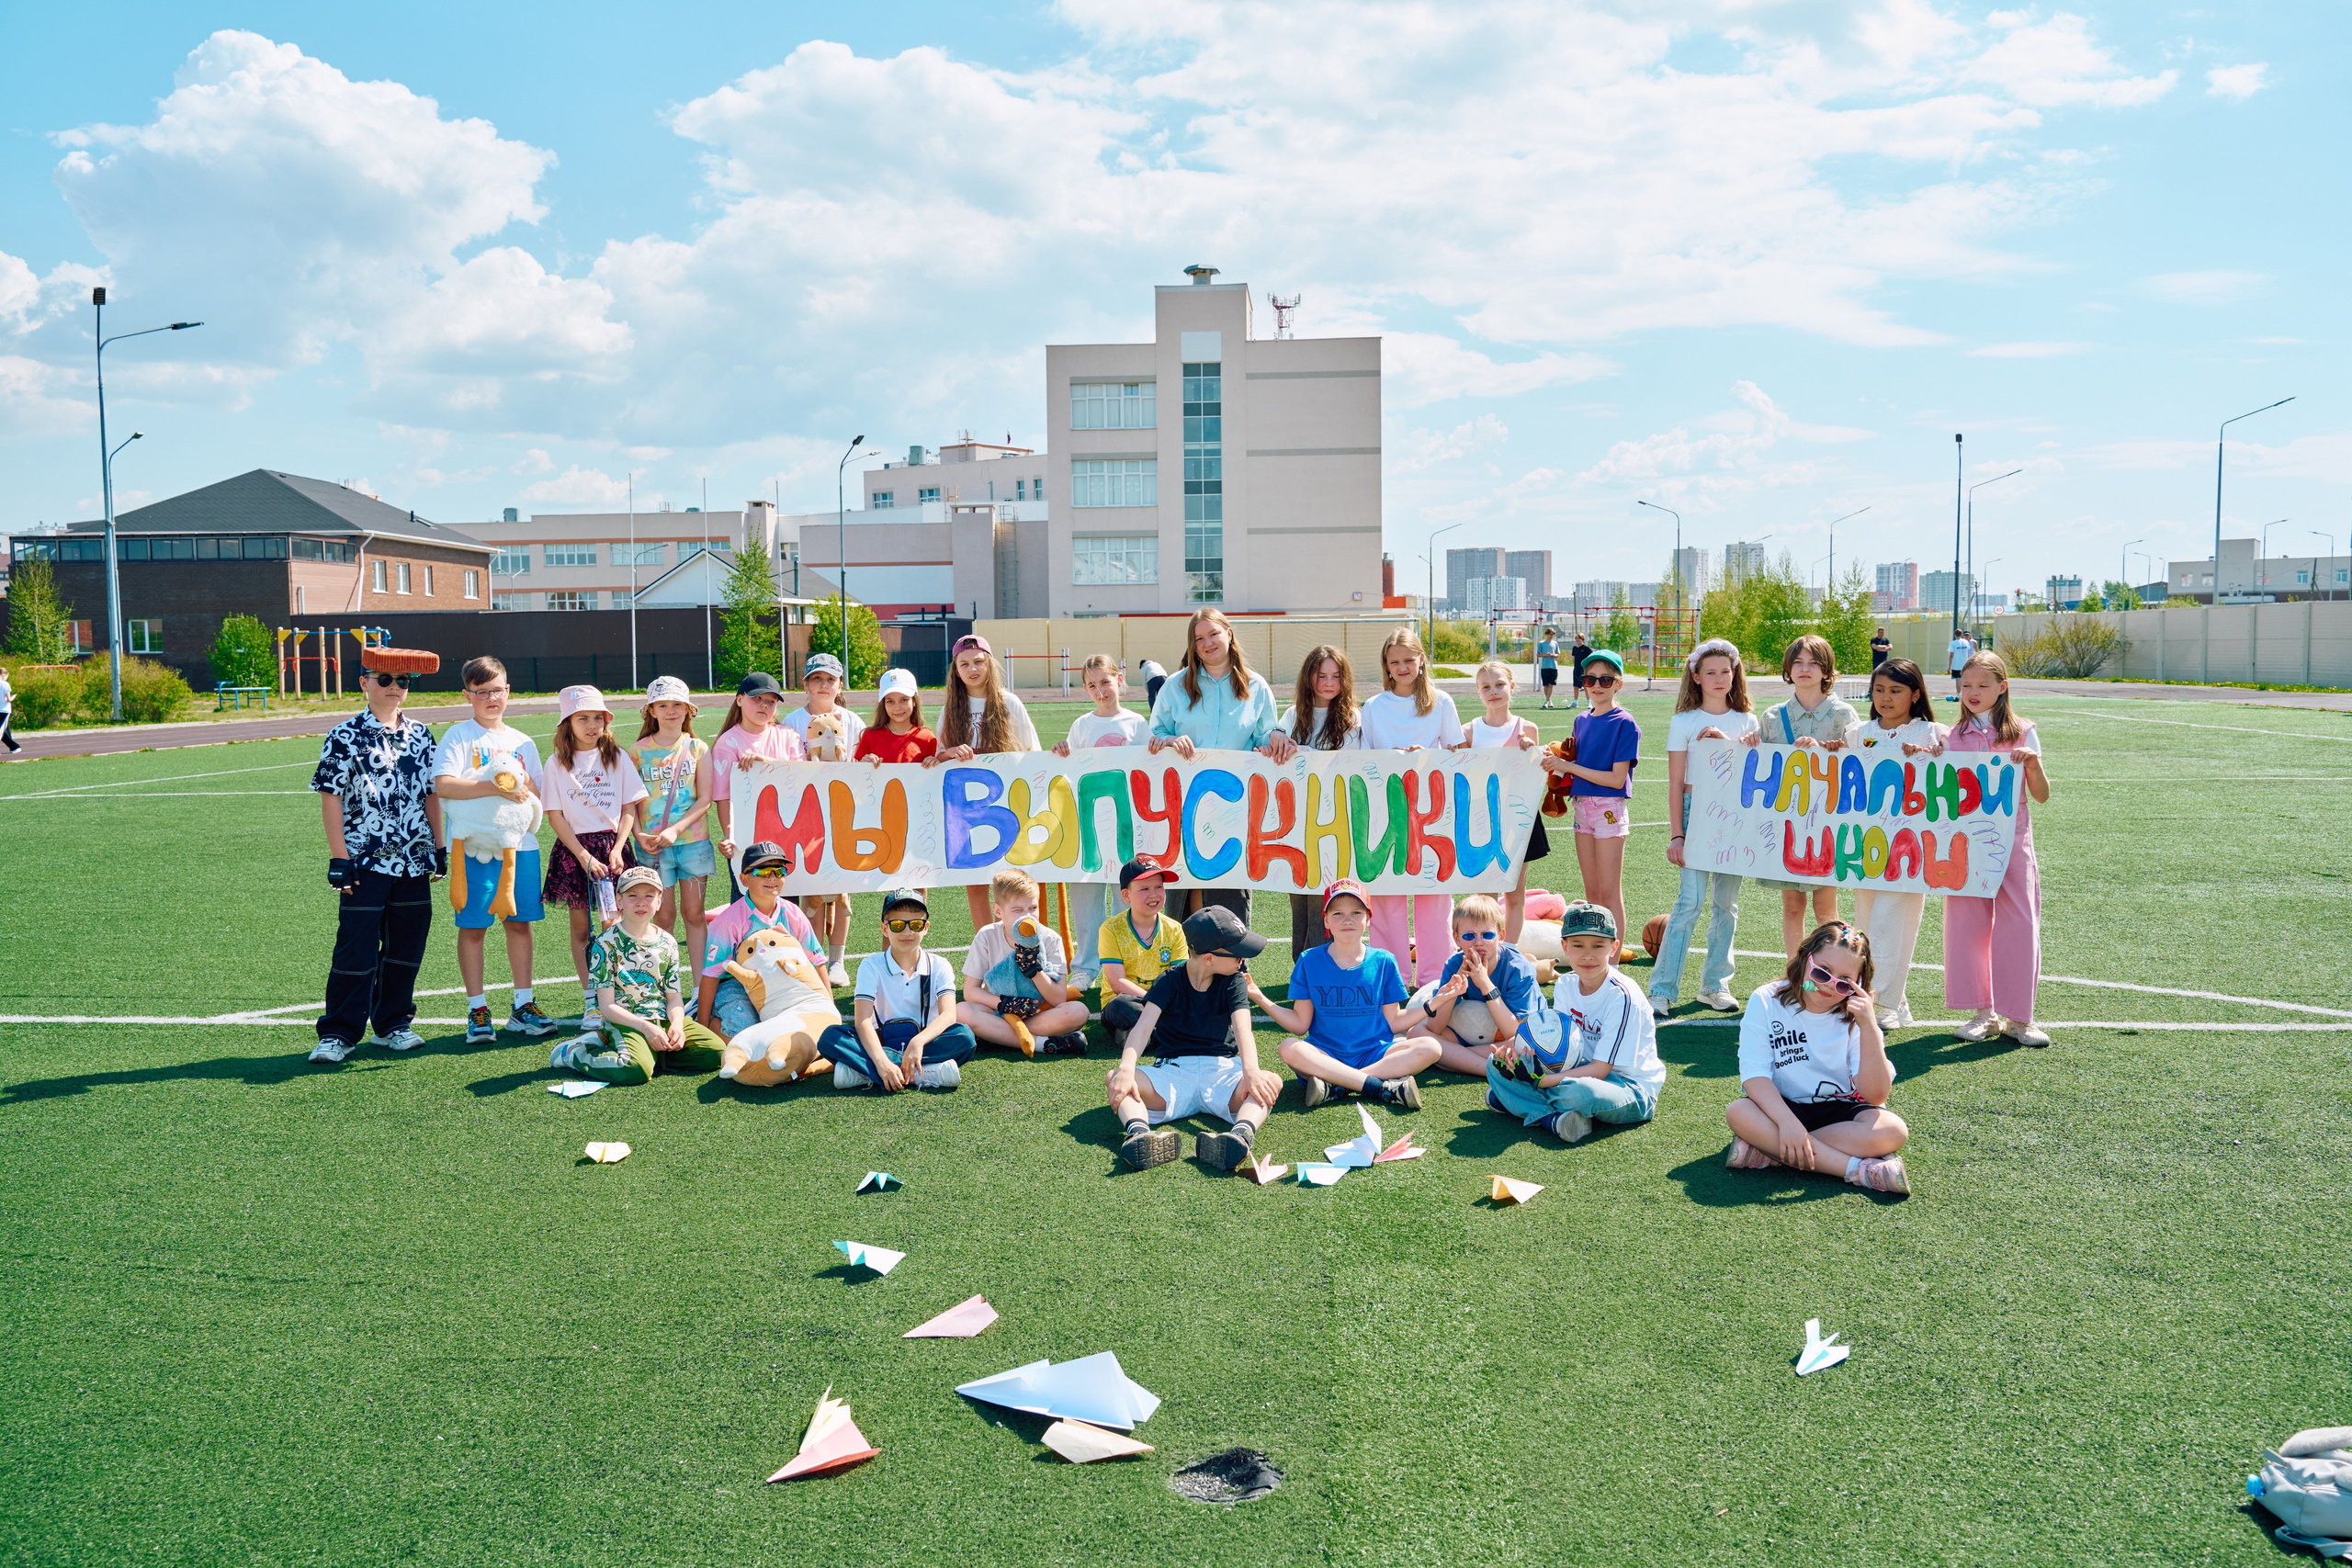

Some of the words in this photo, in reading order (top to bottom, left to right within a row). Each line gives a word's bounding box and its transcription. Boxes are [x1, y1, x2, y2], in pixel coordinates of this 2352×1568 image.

[471, 747, 526, 763] SUMER
[640, 760, 697, 782] LEISRE
[1740, 748, 2015, 822] НАЧАЛЬНОЙ
[753, 777, 909, 874] МЫ
[943, 766, 1511, 888] ВЫПУСКНИКИ
[758, 840, 778, 854] 10
[1782, 819, 1970, 890] ШКОЛЫ
[1780, 1046, 1804, 1057] brings
[1774, 1056, 1792, 1069] good
[1793, 1054, 1810, 1063] luck
